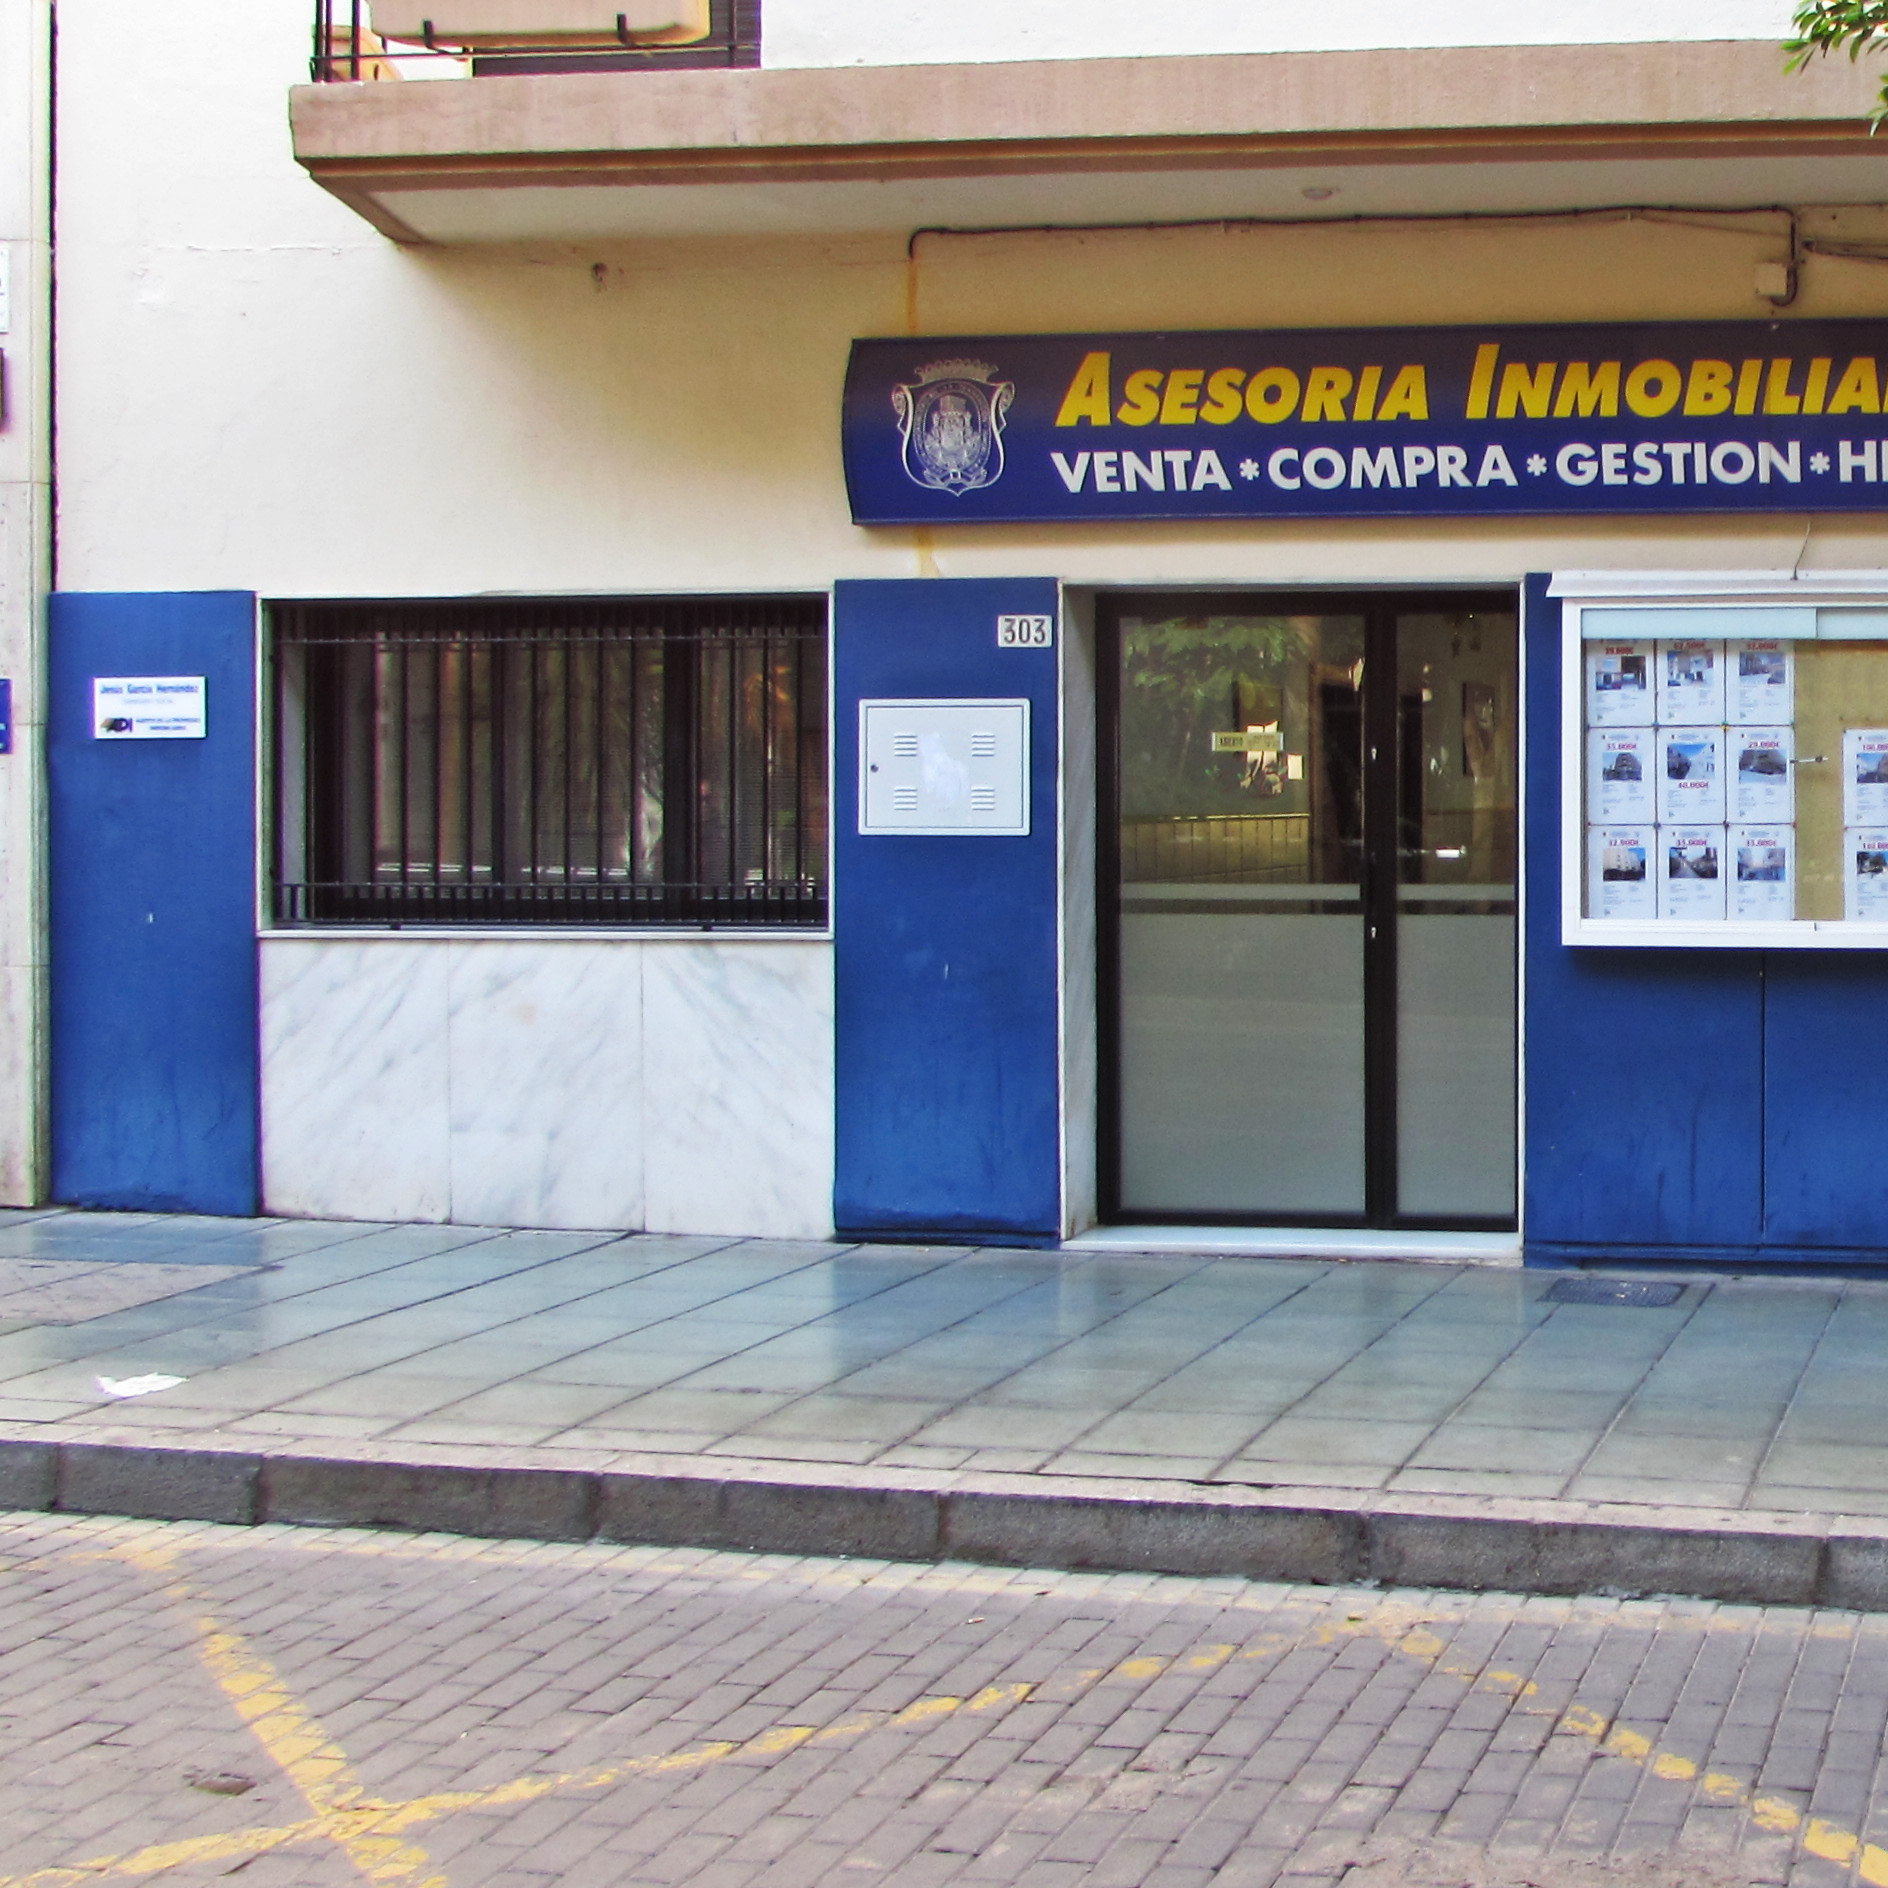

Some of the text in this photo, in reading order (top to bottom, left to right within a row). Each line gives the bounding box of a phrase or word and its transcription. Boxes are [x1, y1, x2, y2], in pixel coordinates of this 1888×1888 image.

[1053, 352, 1429, 426] ASESORIA
[1051, 449, 1232, 493] VENTA
[1268, 445, 1519, 491] COMPRA
[1556, 441, 1801, 487] GESTION
[1004, 618, 1046, 643] 303
